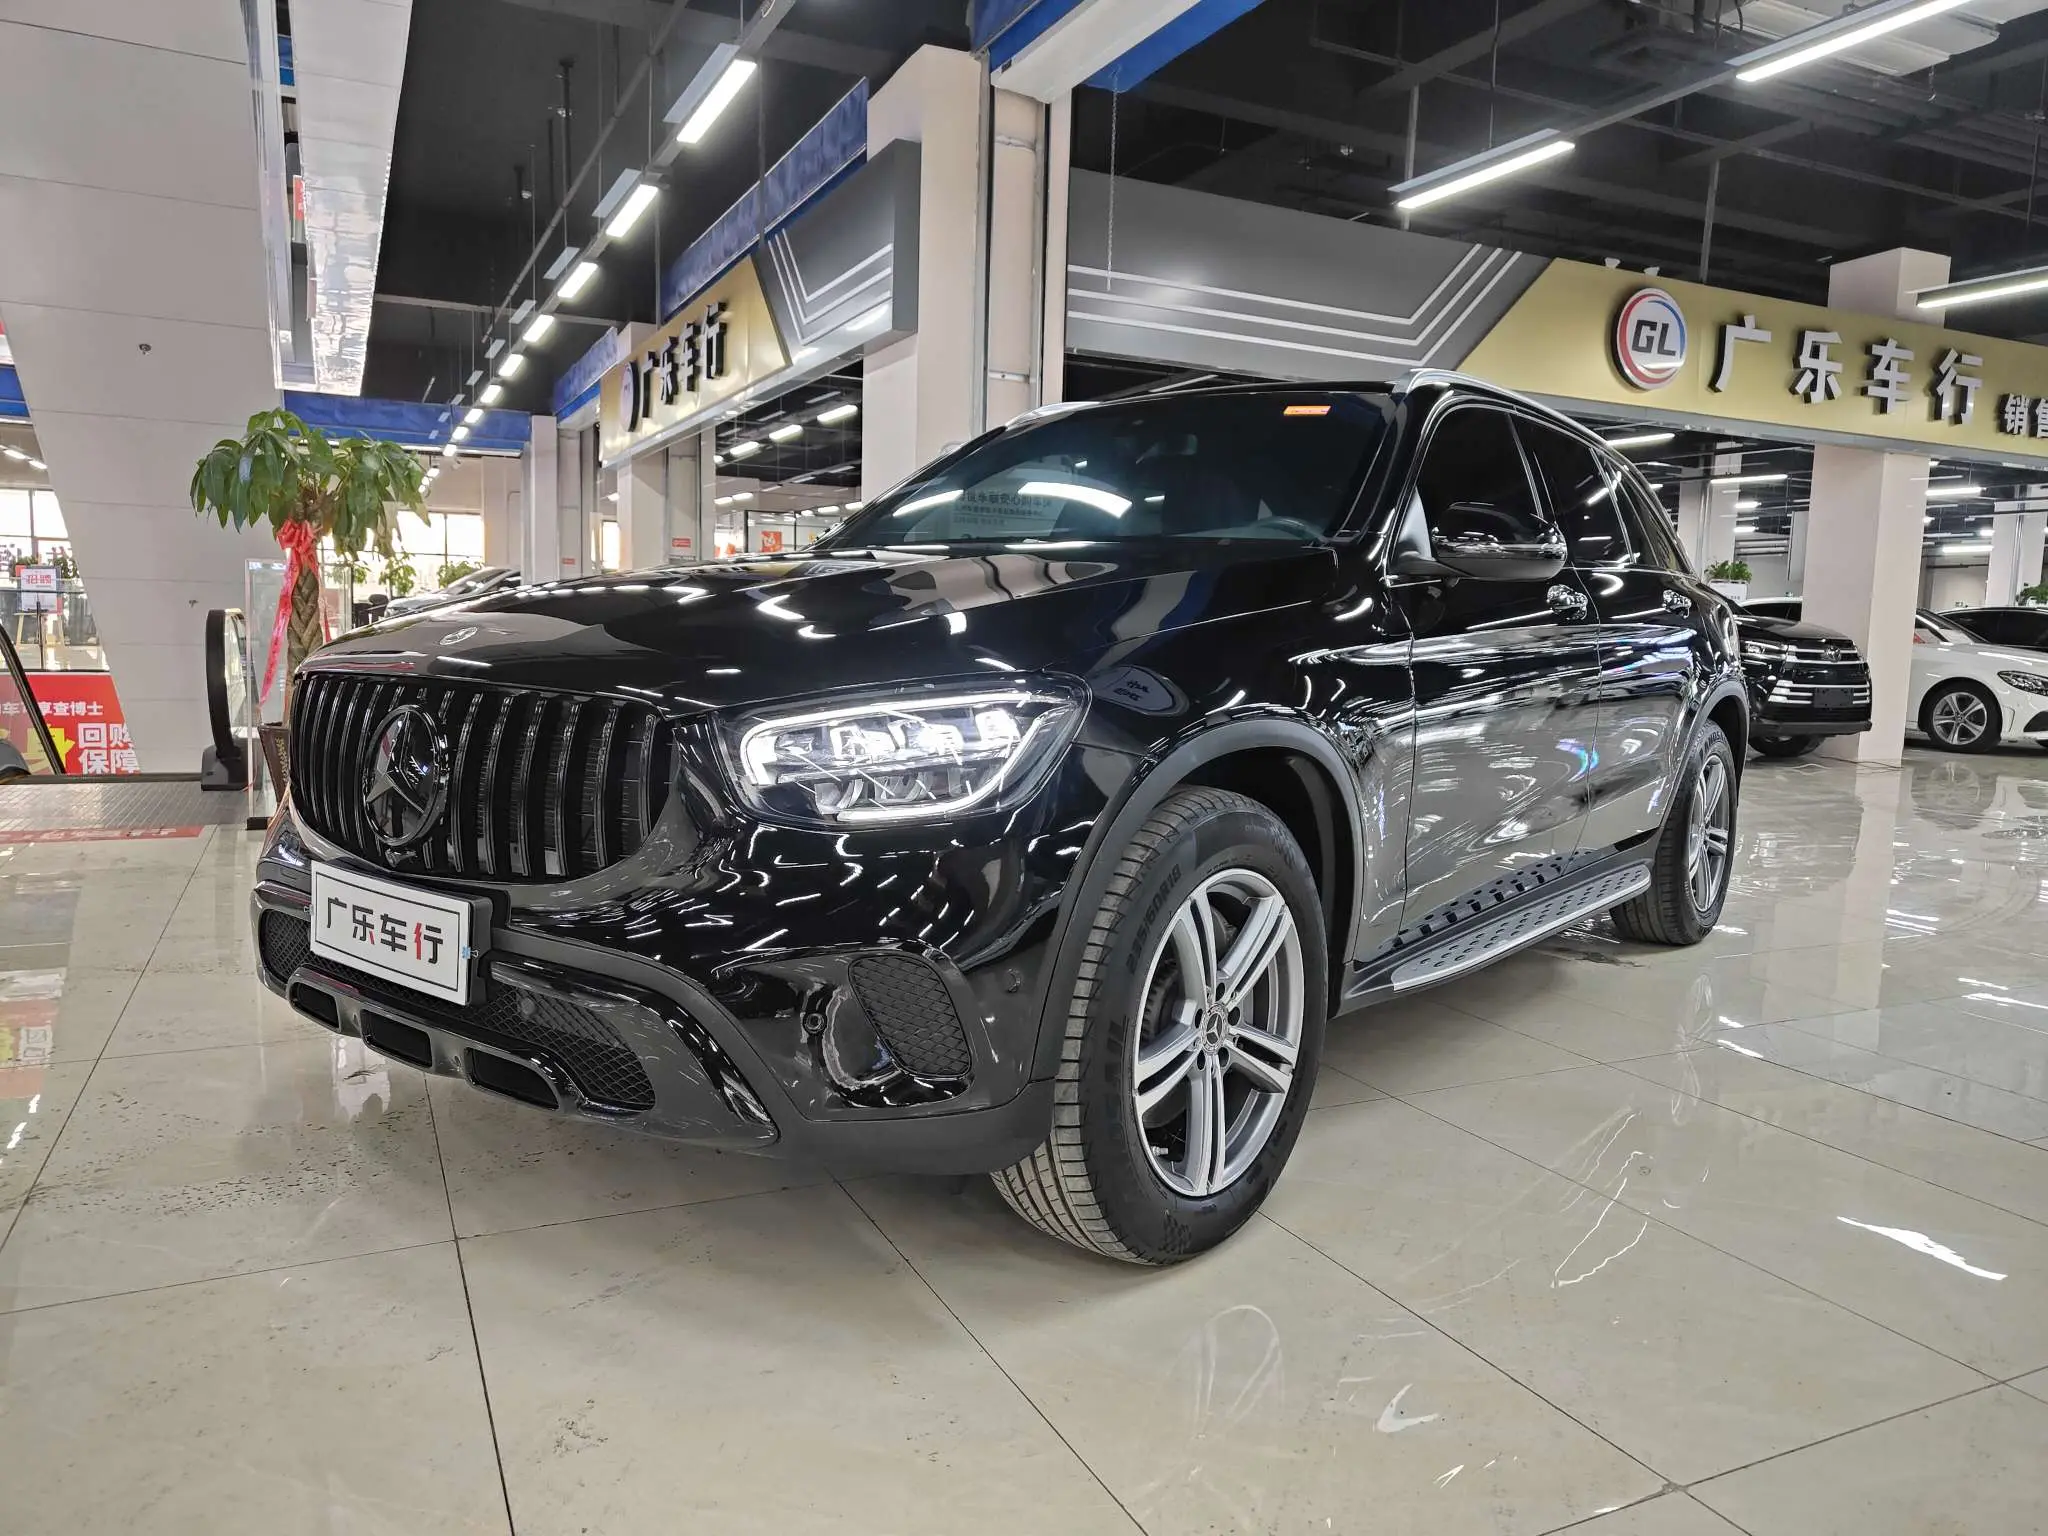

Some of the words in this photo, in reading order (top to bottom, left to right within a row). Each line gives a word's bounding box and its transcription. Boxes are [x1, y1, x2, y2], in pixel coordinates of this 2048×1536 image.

[642, 302, 727, 418] 广乐车行
[1631, 319, 1677, 357] GL
[1710, 314, 1983, 426] 广乐车行
[0, 701, 104, 716] 车享查博士
[327, 897, 443, 964] 广乐车行
